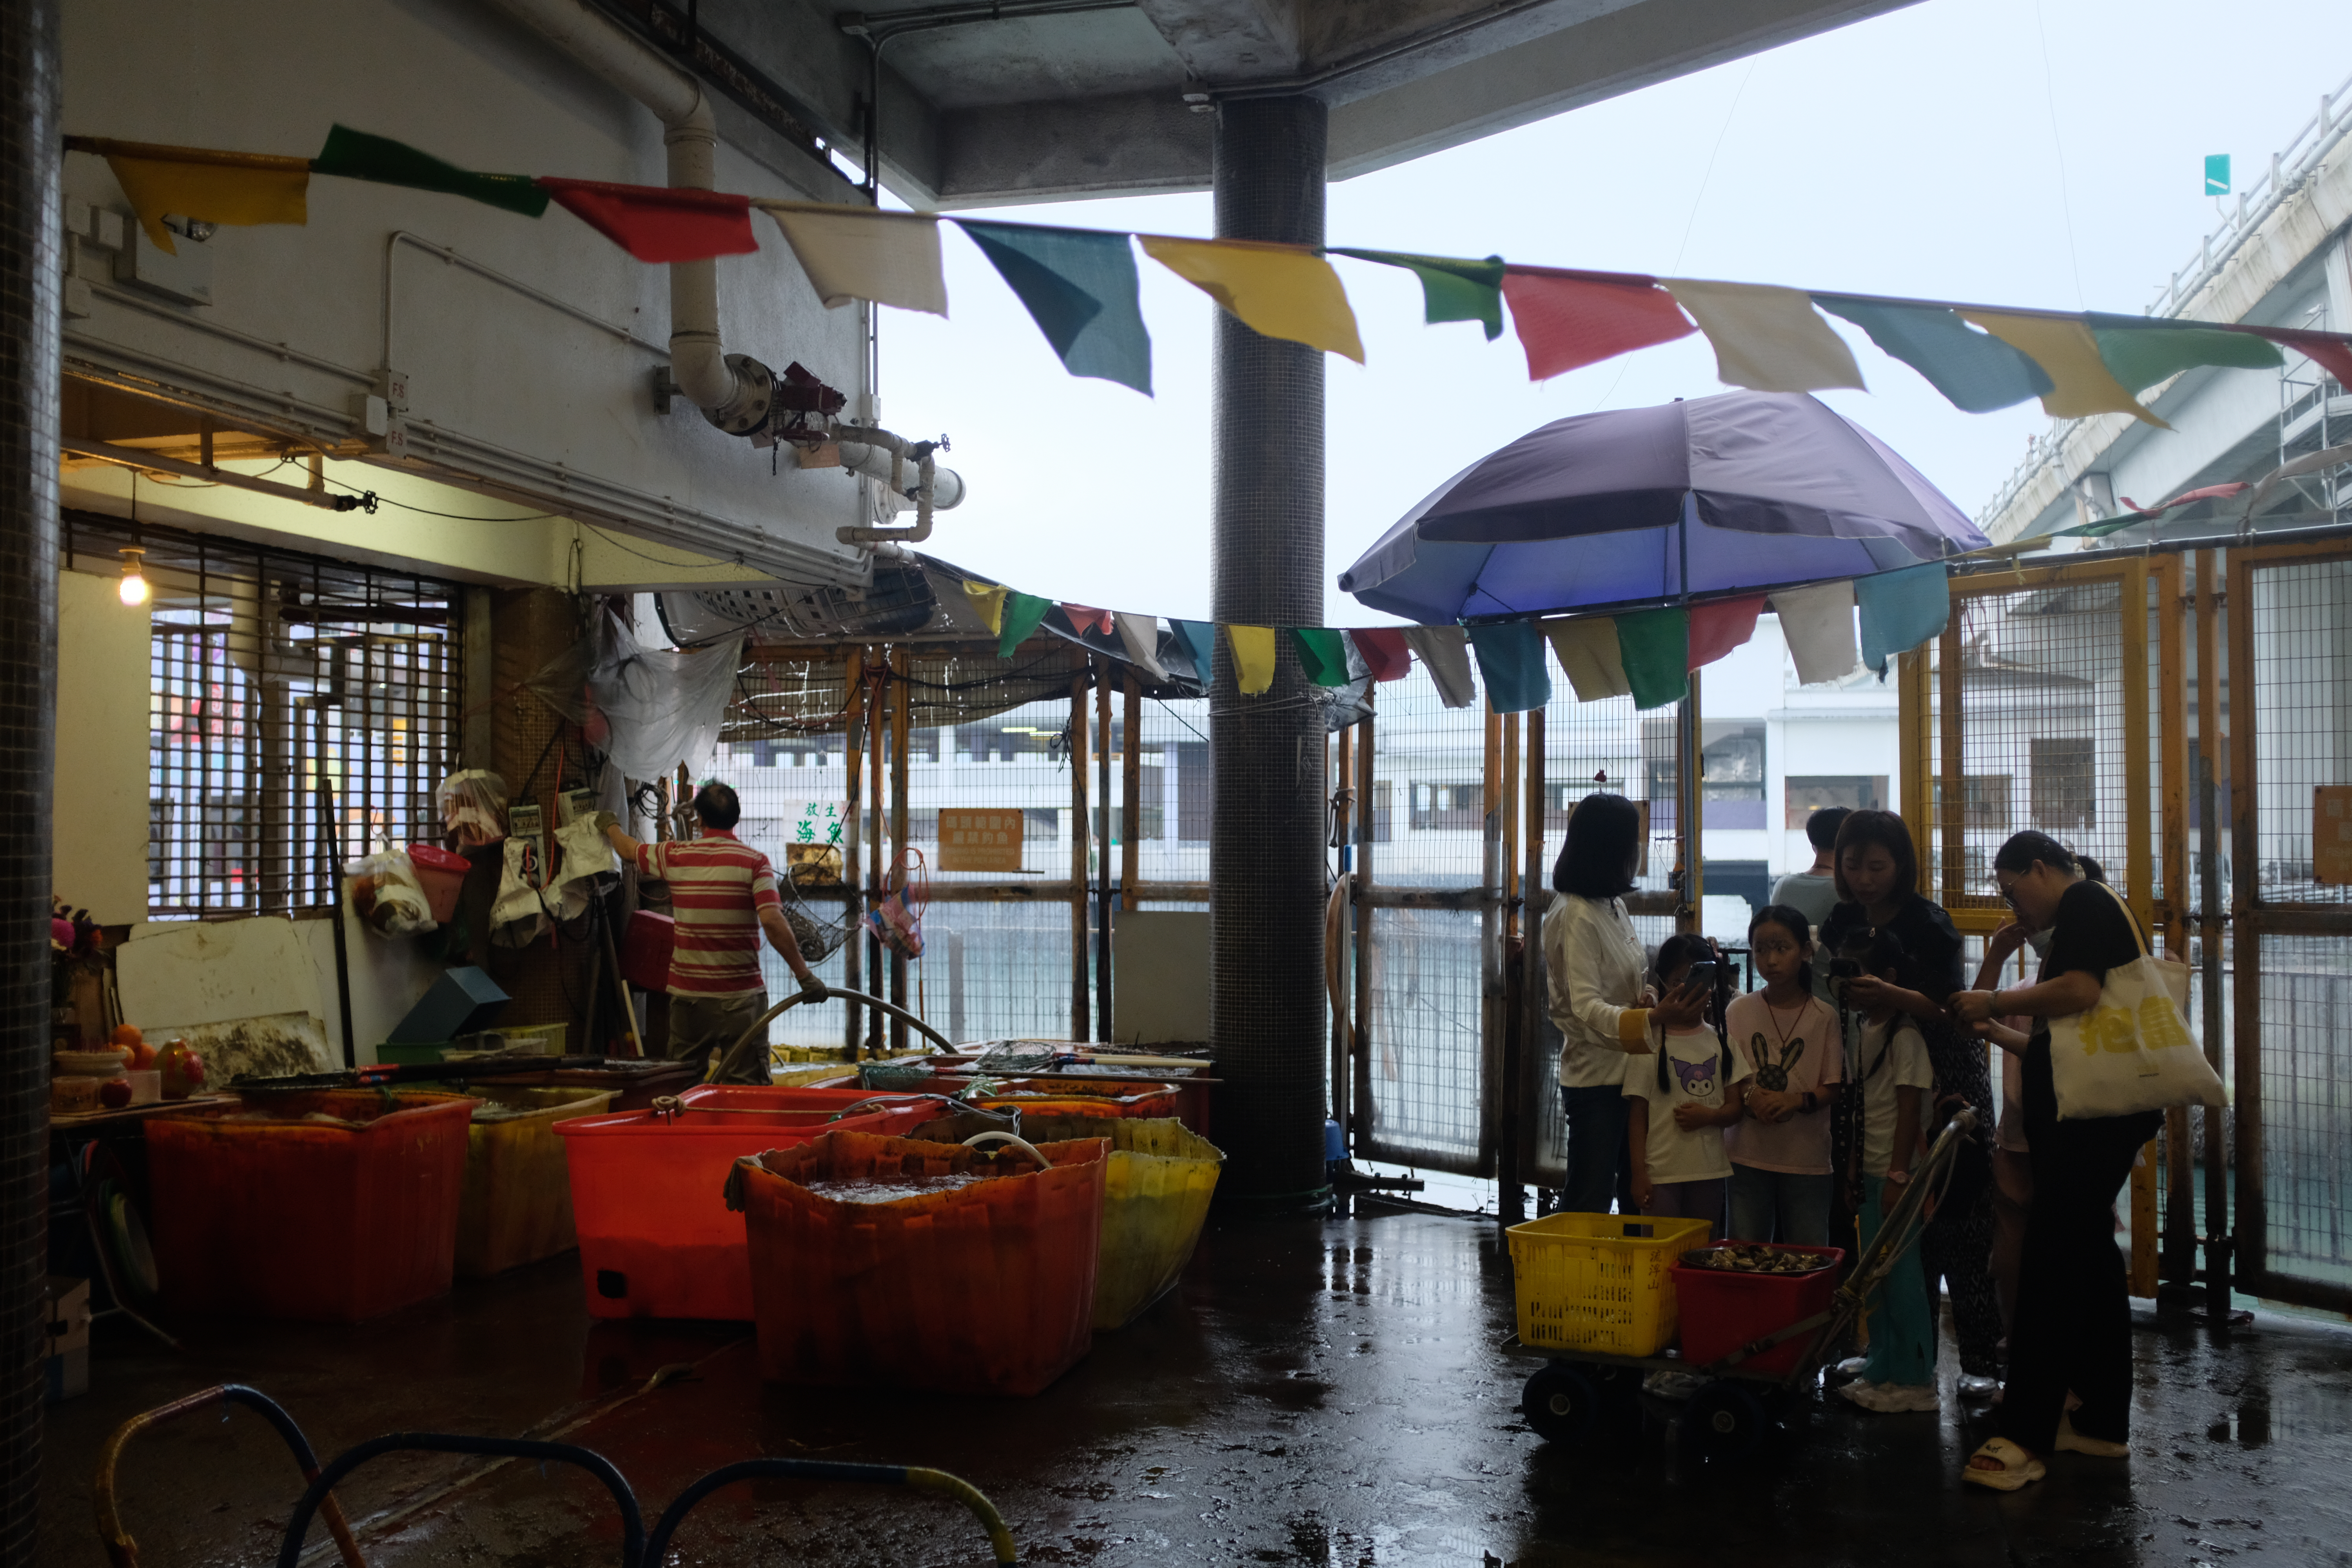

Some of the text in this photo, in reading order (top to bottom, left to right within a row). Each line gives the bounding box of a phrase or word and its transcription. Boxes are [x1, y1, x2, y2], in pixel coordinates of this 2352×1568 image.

[805, 802, 837, 817] 放生
[796, 820, 844, 843] 海魚
[1648, 1249, 1662, 1290] 流浮山
